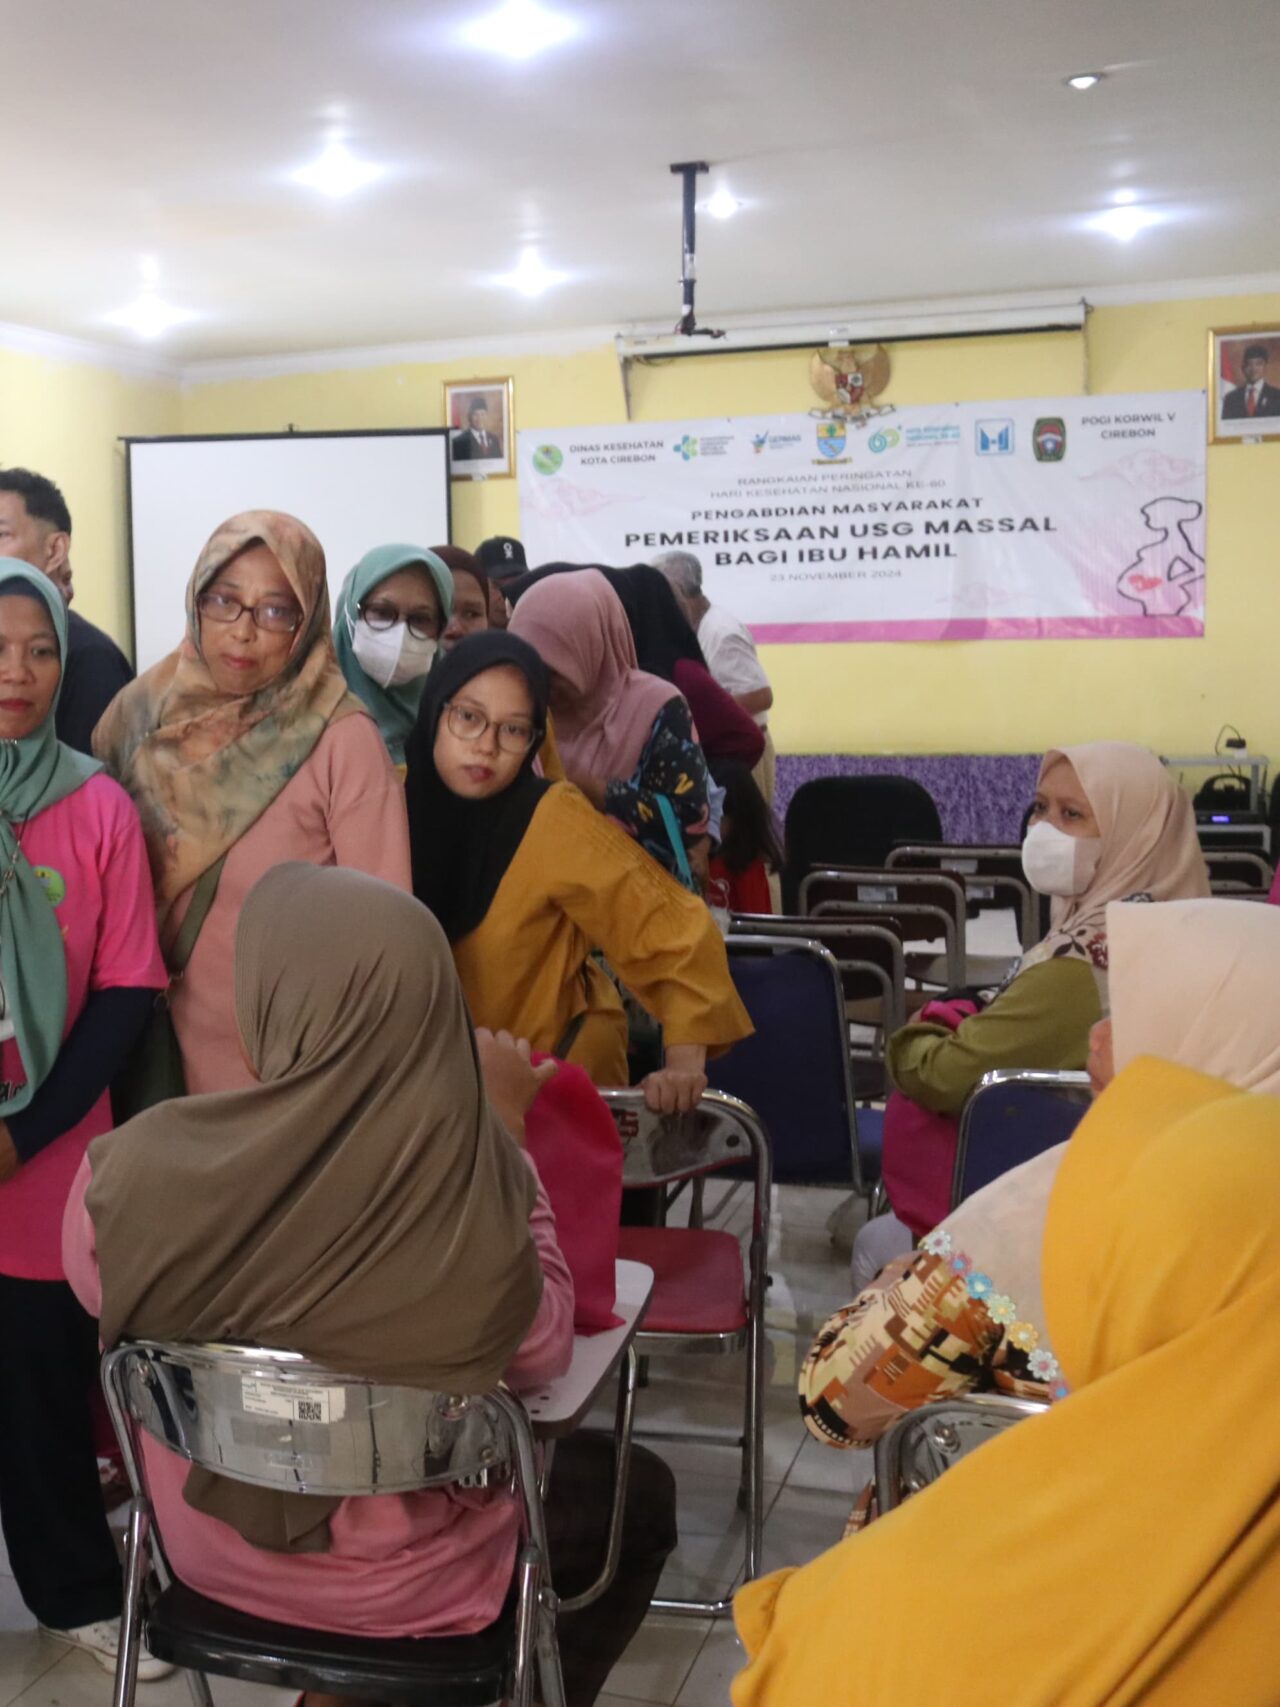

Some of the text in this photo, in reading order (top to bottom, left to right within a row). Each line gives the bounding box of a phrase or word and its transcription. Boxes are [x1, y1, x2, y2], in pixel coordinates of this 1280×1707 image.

[1081, 412, 1176, 426] POGI KORWIL V
[1101, 429, 1156, 440] CIREBON
[570, 440, 664, 453] DINAS KESEHATAN
[581, 454, 656, 466] KOTA CIREBON
[738, 470, 912, 486] RANGKAIAN PERINGATAN
[711, 489, 743, 499] HARI
[746, 486, 829, 498] KESEHATAN
[832, 482, 901, 495] NASIONAL
[691, 497, 983, 521] PENGABDIAN MASYARAKAT
[625, 516, 1057, 547] PEMERIKSAAN USG MASSAL
[715, 543, 957, 566] BAGI IBU HAMIL
[771, 569, 902, 582] 23 NOVEMBER 2024
